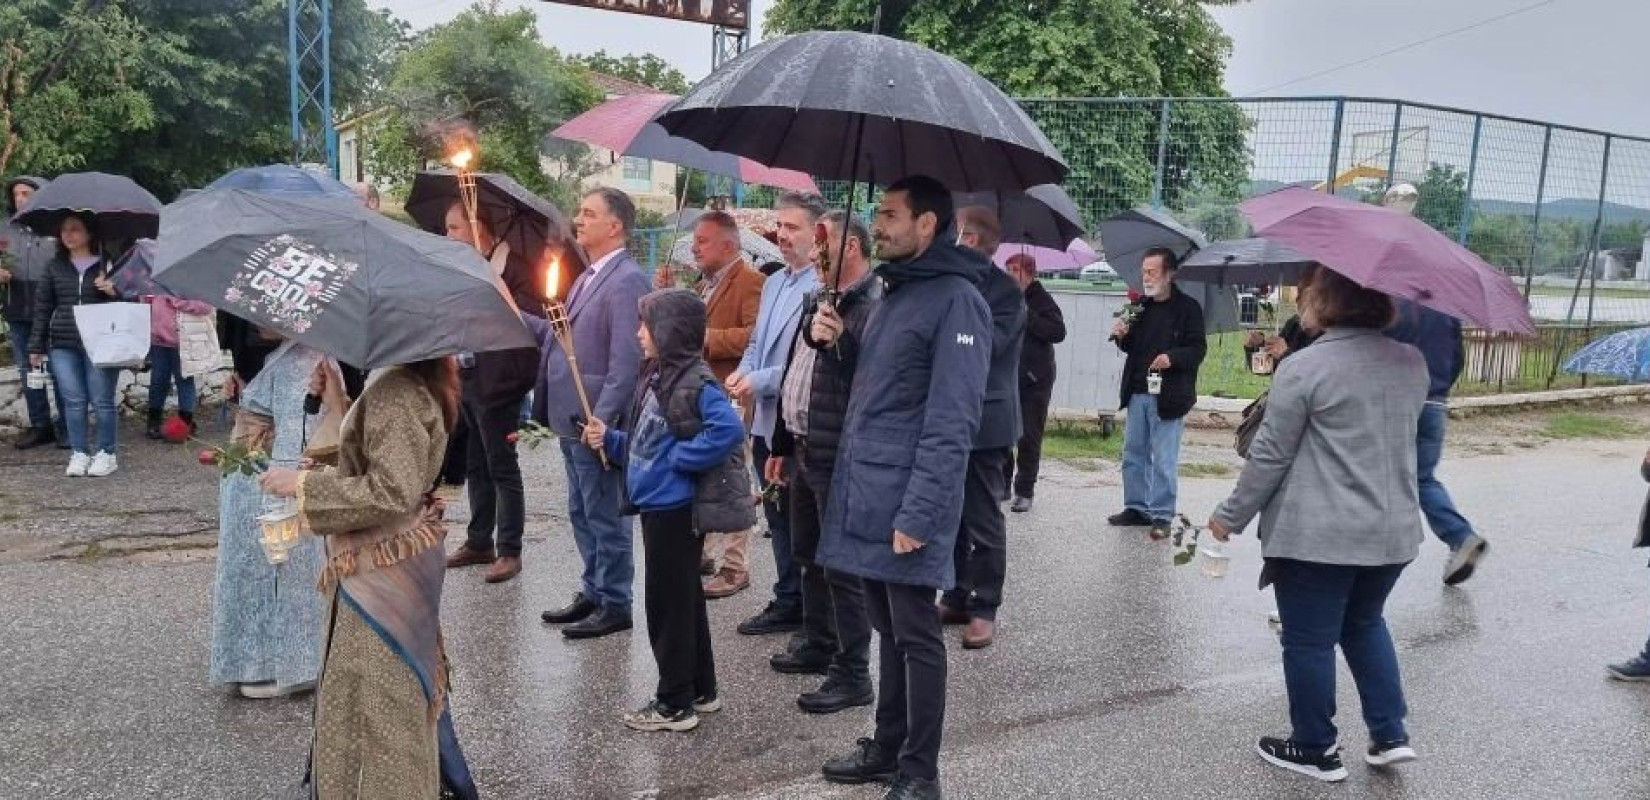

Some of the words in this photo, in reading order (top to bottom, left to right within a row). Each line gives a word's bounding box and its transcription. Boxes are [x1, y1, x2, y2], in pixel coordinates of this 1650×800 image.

[267, 246, 339, 285] BE
[250, 269, 311, 312] COOL
[956, 332, 974, 347] HH
